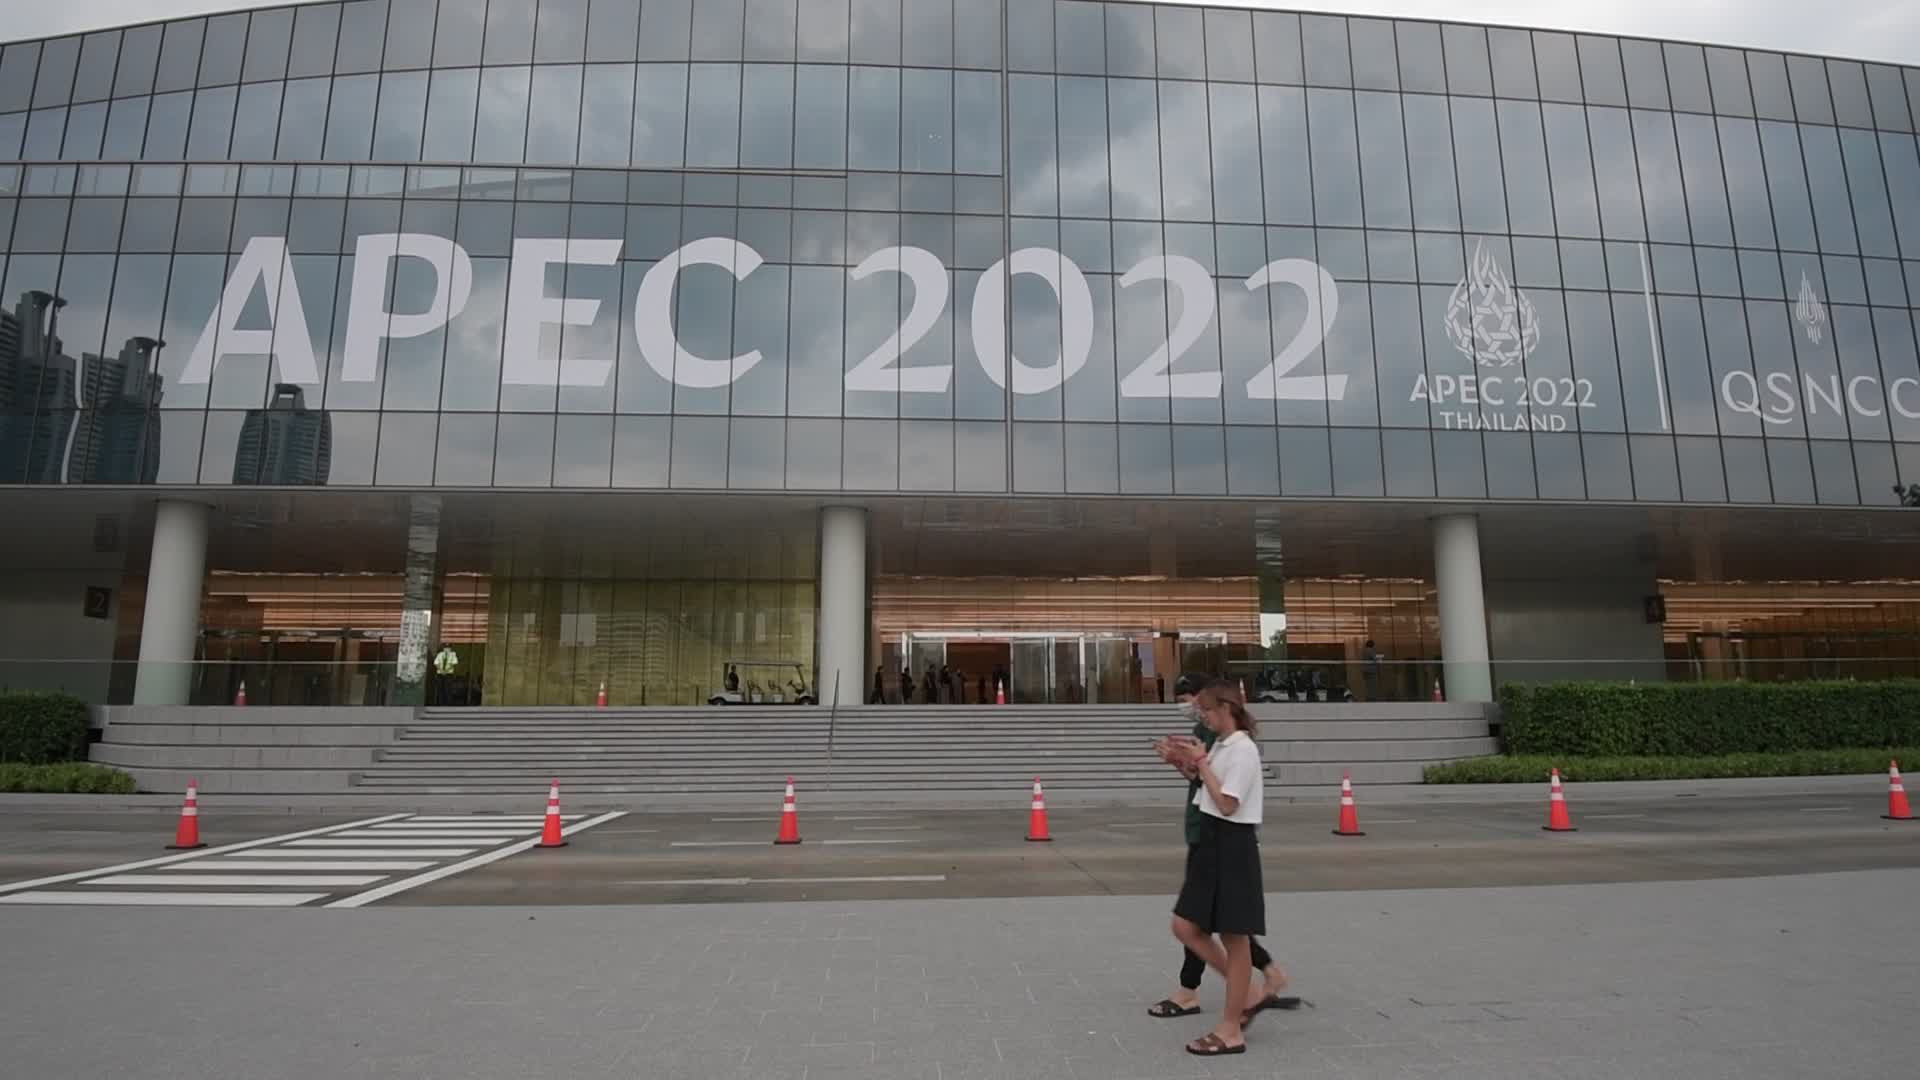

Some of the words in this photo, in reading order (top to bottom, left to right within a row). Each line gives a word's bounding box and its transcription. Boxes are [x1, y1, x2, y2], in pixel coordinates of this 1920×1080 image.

[178, 232, 765, 388] APEC
[844, 245, 1349, 400] 2022
[1409, 373, 1505, 406] APEC
[1514, 376, 1597, 408] 2022
[1721, 370, 1920, 424] QSNCC
[1440, 411, 1566, 432] THAILAND
